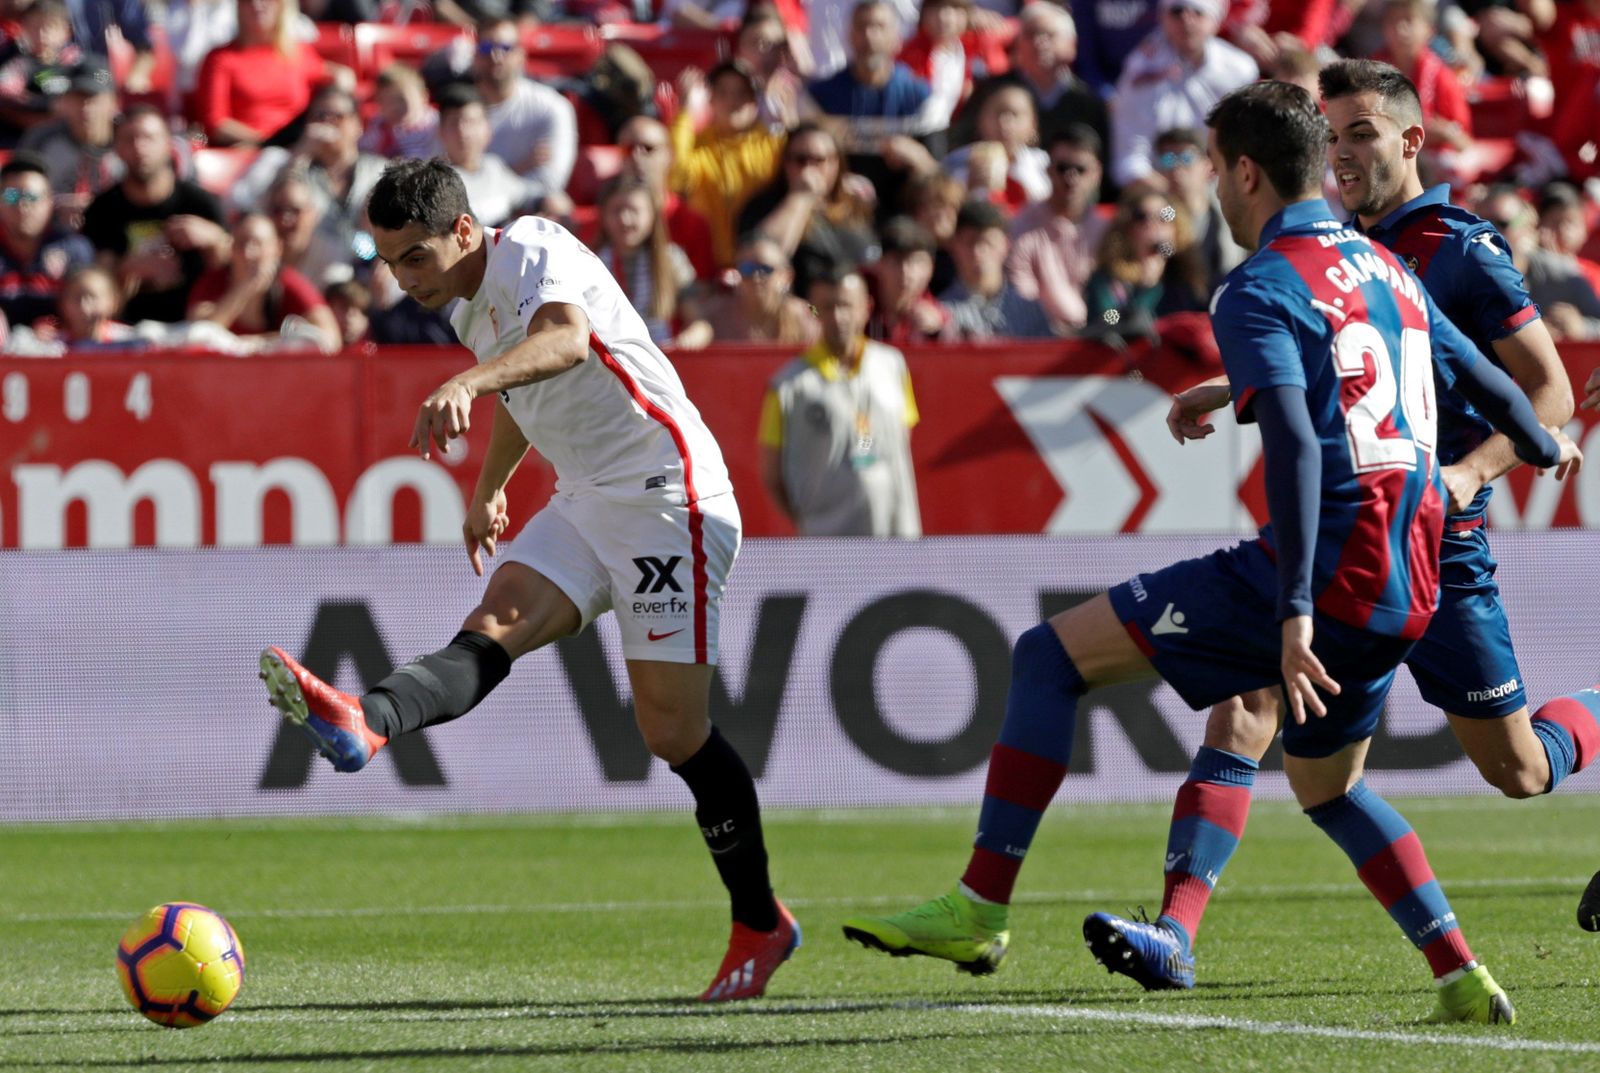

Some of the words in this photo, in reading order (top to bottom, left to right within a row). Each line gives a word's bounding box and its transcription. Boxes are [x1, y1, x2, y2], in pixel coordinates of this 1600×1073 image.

[1331, 321, 1438, 480] 24
[632, 597, 689, 614] everfx
[257, 598, 449, 790] A
[1467, 678, 1519, 702] macron
